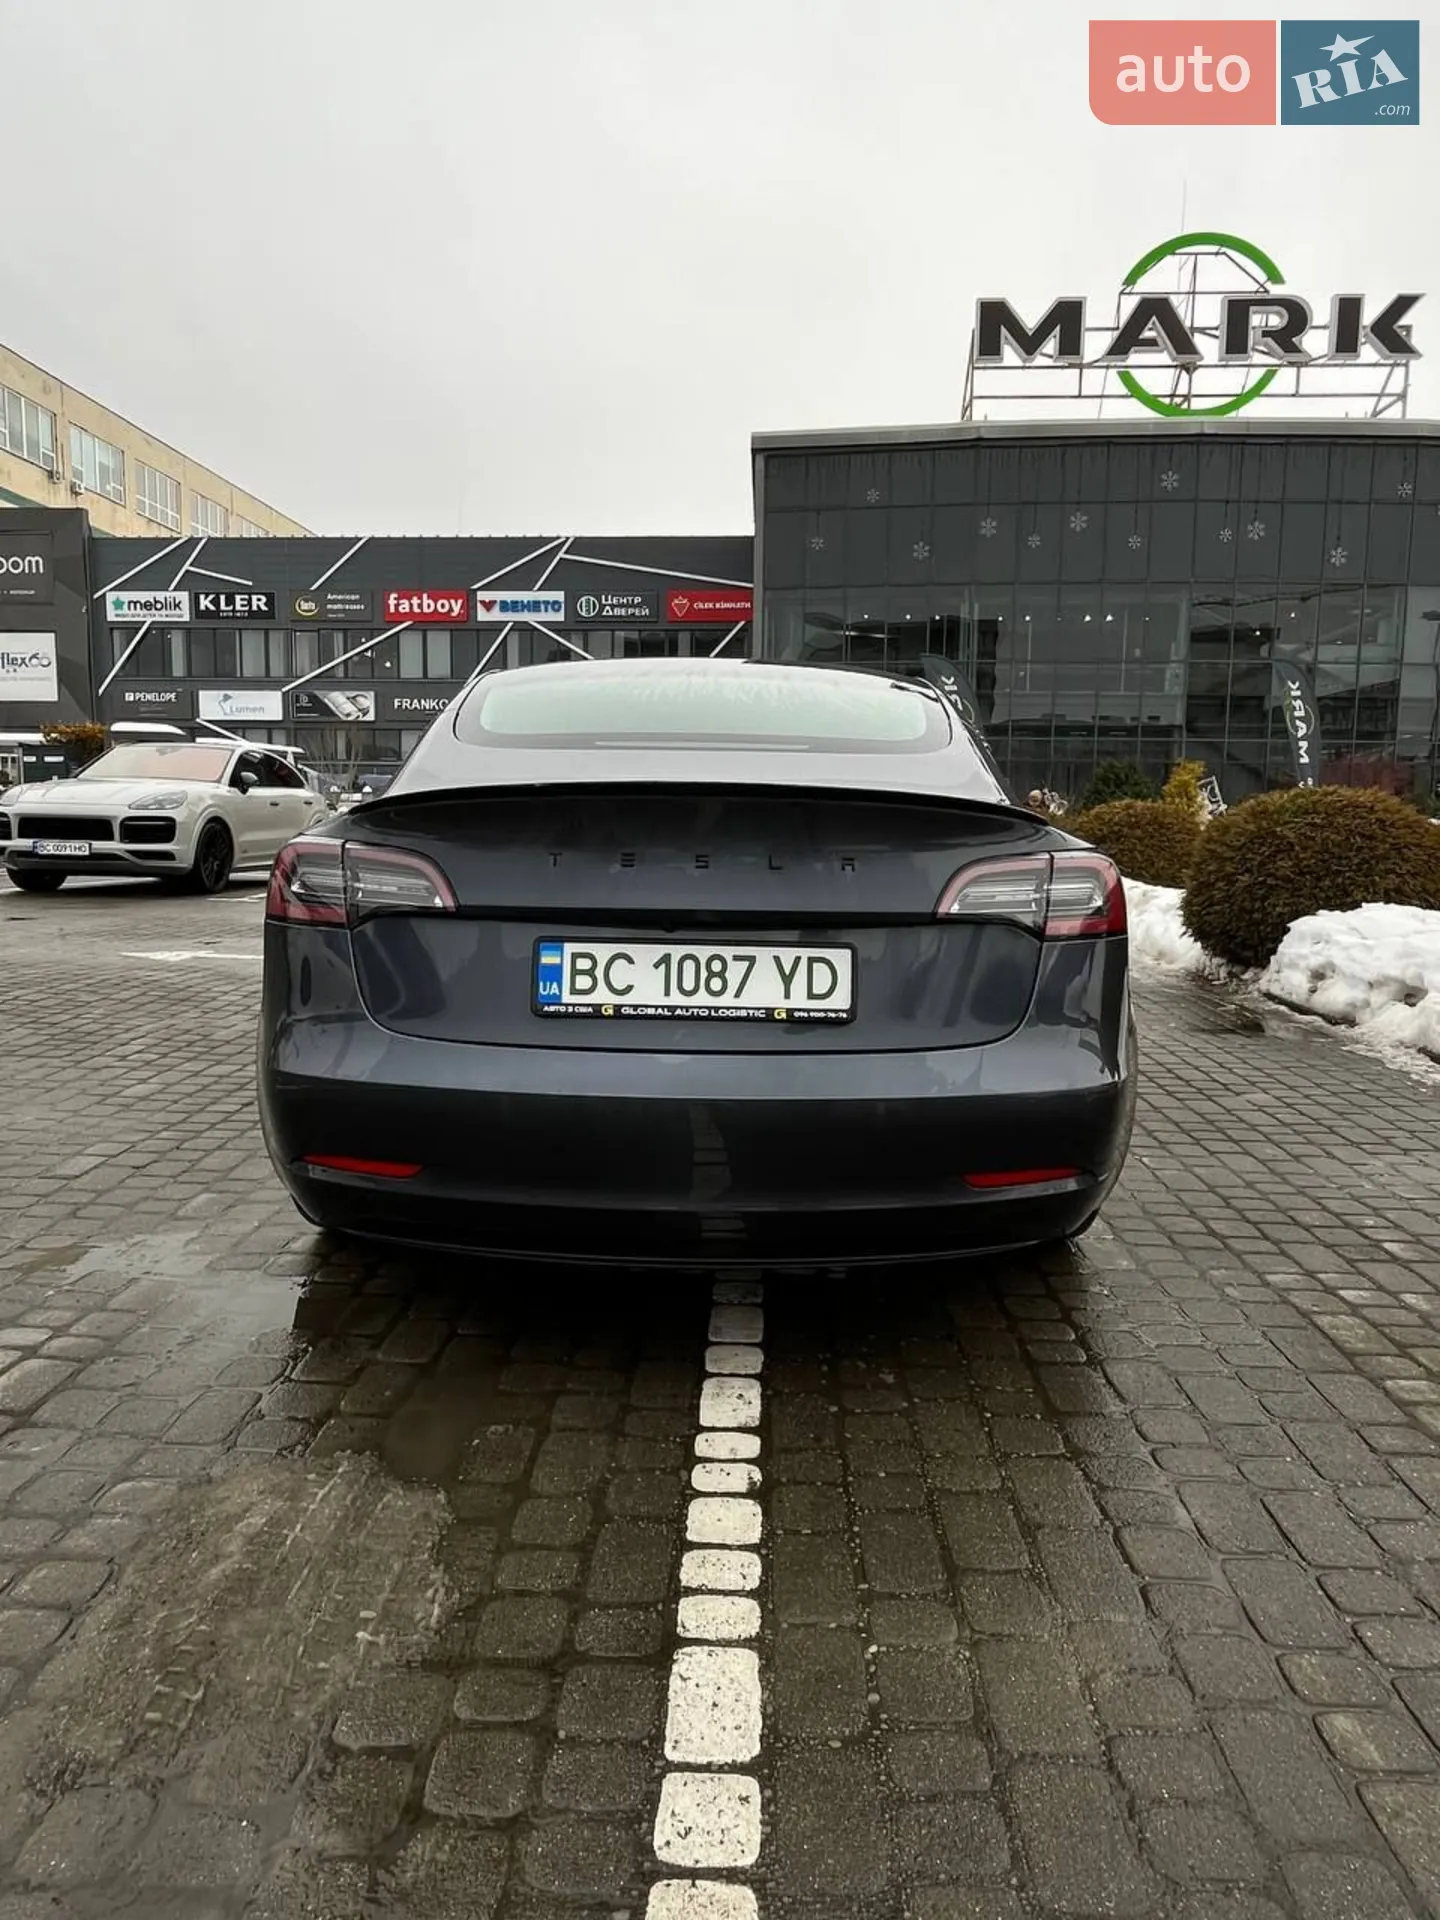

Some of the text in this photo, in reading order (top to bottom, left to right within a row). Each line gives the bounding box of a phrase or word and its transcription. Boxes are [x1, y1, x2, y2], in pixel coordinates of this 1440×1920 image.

[975, 292, 1427, 363] MARK
[127, 596, 182, 611] meblik
[199, 594, 269, 611] KLER
[135, 692, 177, 702] PENELOPE
[1287, 680, 1310, 764] MARK
[549, 852, 856, 872] TESLA
[569, 951, 839, 1001] BC 1087 YD
[539, 982, 560, 995] UA
[621, 1006, 672, 1016] GLOBAL
[674, 1007, 709, 1016] AUTO
[711, 1008, 767, 1018] LOGISTIC
